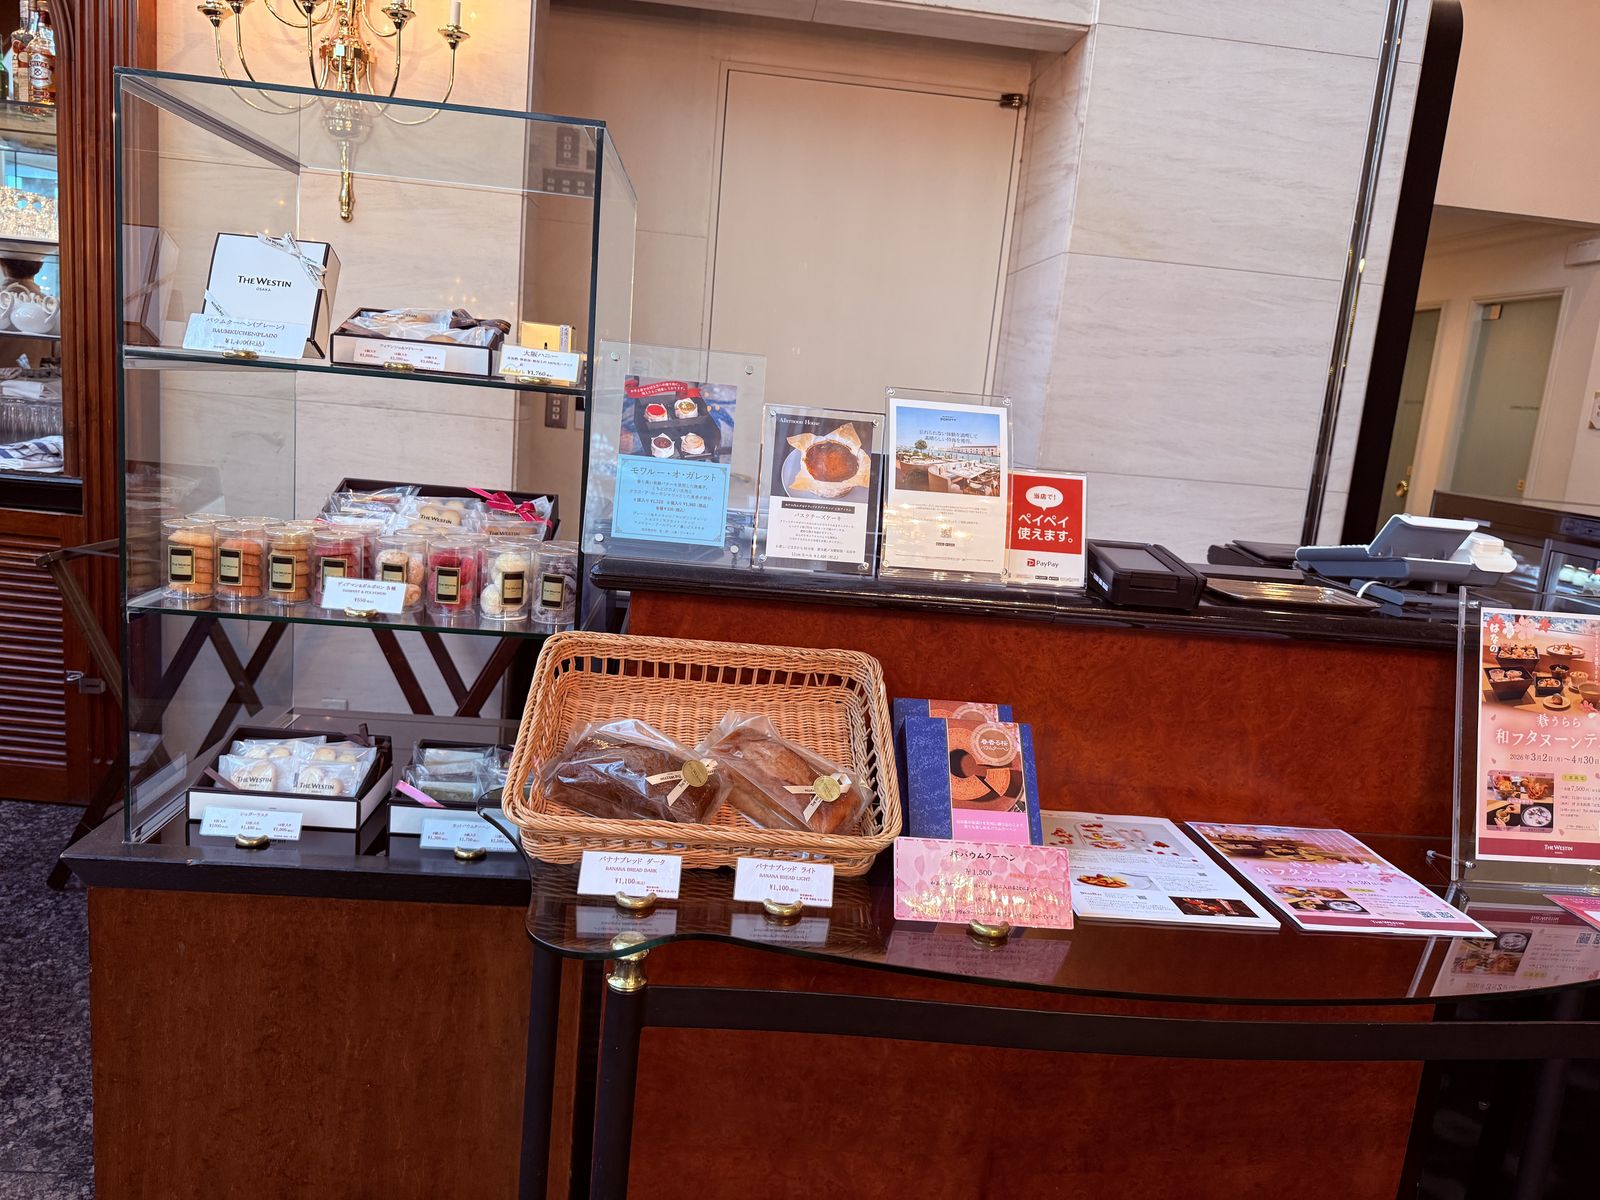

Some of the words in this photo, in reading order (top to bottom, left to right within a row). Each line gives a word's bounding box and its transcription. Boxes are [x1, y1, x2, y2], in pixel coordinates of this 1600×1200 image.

[238, 275, 255, 285] THE
[256, 277, 292, 288] WESTIN
[630, 467, 717, 482] モワルー・オ・ガレット
[1033, 492, 1056, 501] 当店で!
[1018, 513, 1069, 528] ペイペイ
[1017, 526, 1073, 543] 使えます。
[1036, 560, 1059, 568] PayPay
[1489, 622, 1500, 653] はなの
[1536, 713, 1581, 728] 春うらら
[1496, 728, 1600, 749] 和フタヌーンテ
[600, 855, 643, 865] バナナブレッド
[647, 858, 666, 866] ダーク
[755, 863, 797, 872] バナナブレッド
